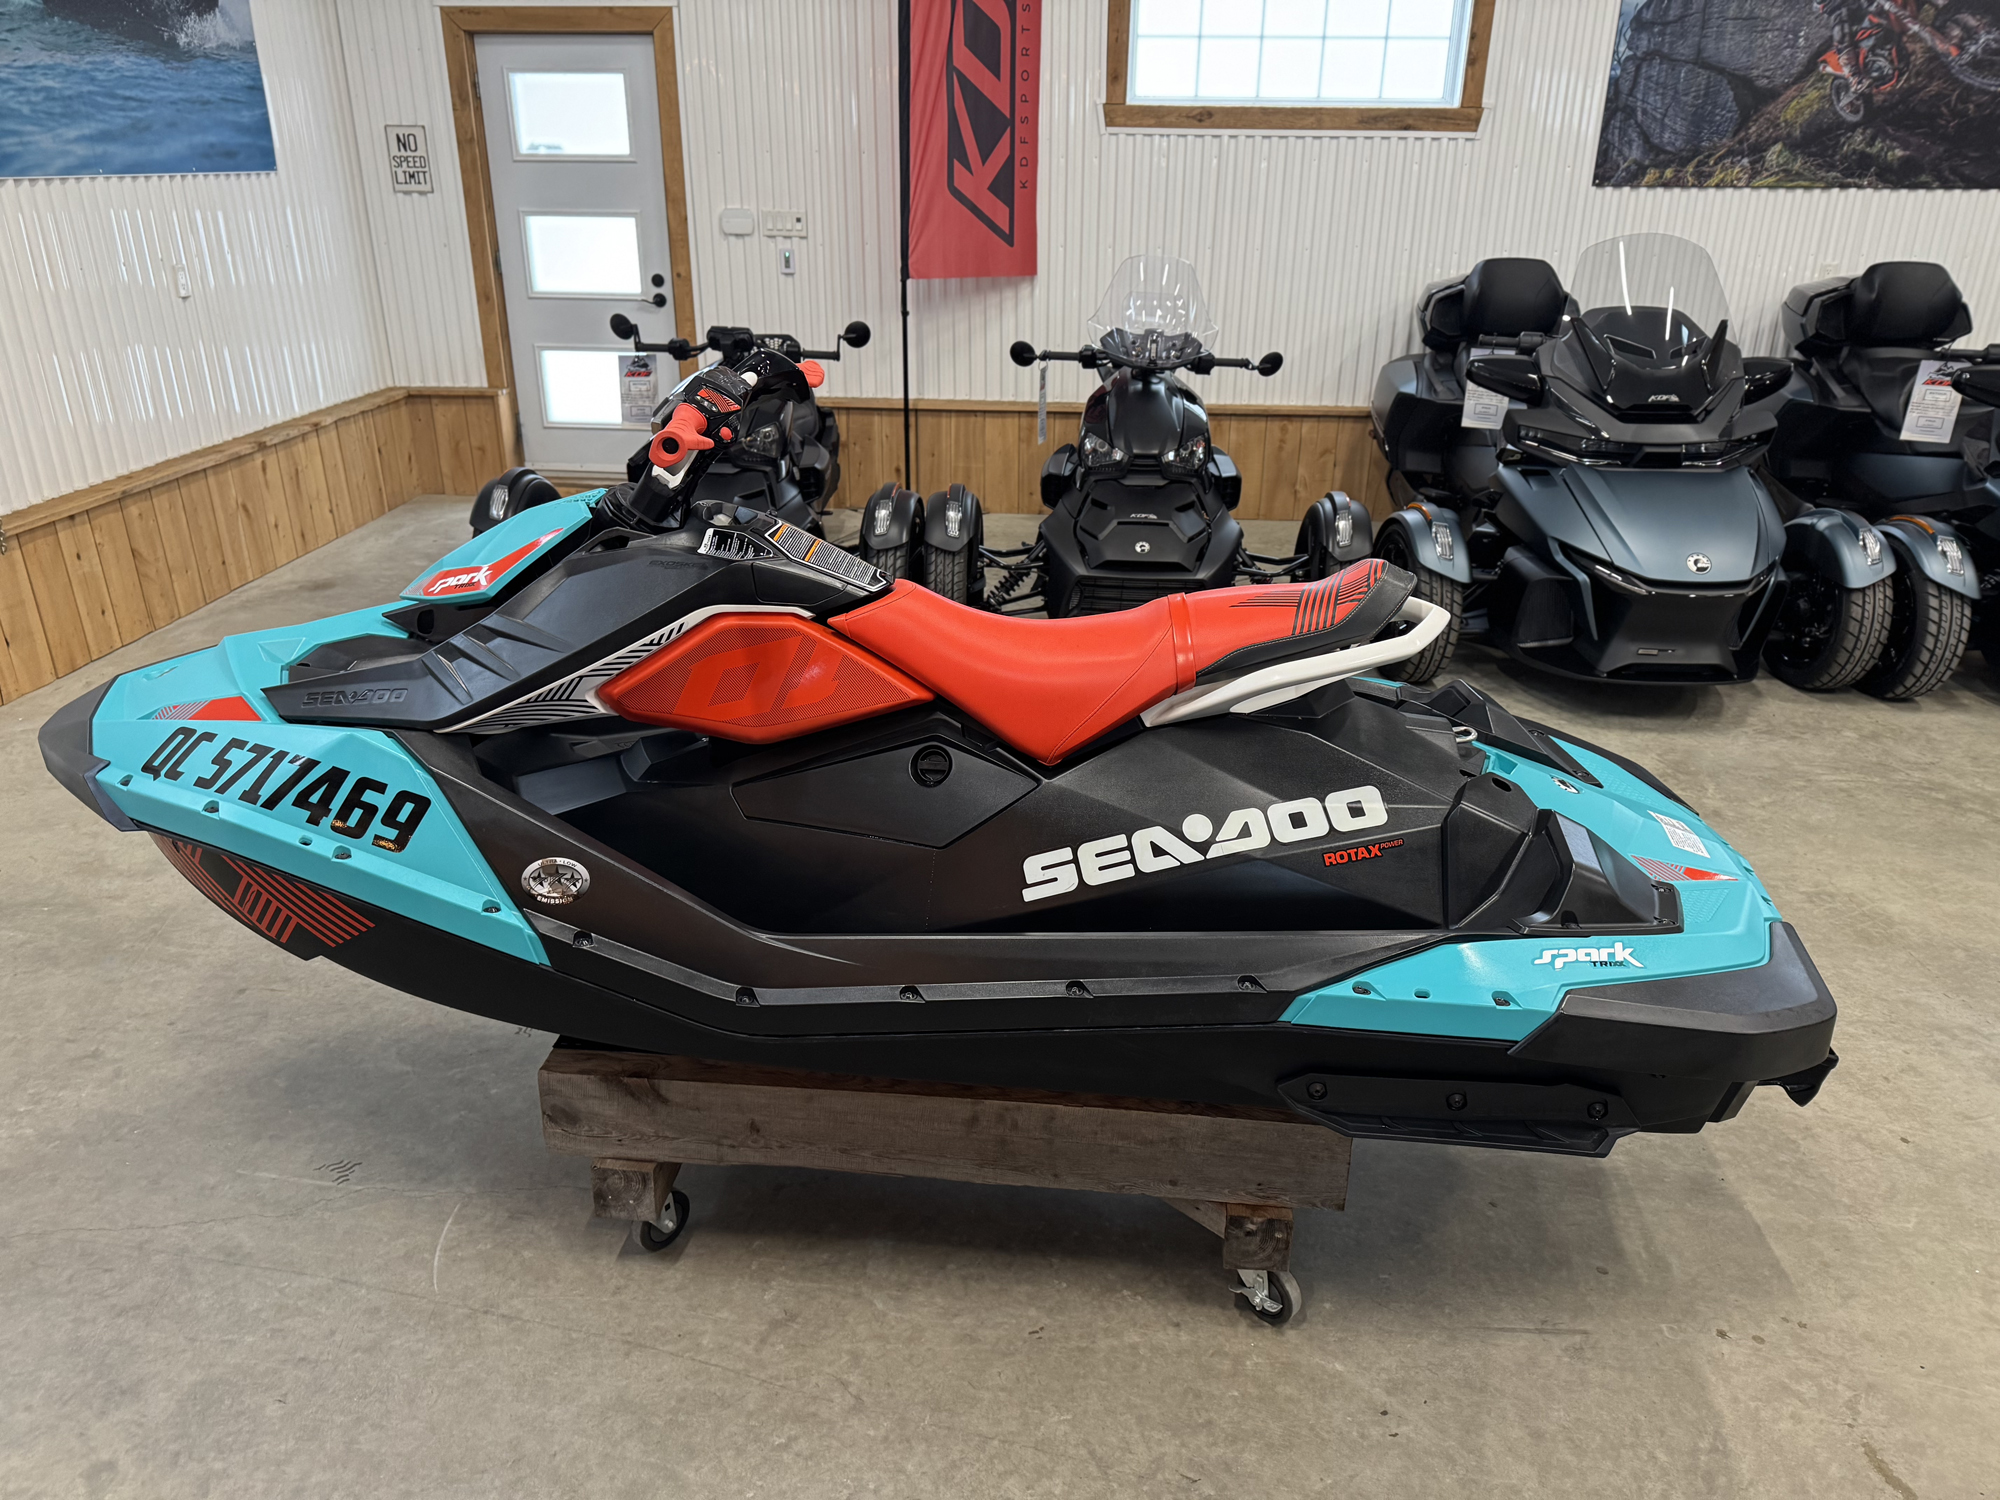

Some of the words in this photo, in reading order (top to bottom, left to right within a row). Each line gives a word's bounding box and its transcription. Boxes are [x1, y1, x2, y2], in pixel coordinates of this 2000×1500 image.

[396, 133, 418, 153] NO
[392, 155, 427, 169] SPEED
[394, 170, 428, 185] LIMIT
[428, 566, 493, 594] spark
[141, 726, 218, 781] QC
[193, 737, 432, 853] 5717469
[1323, 844, 1382, 867] ROTAX
[1380, 839, 1404, 849] POWER
[1534, 942, 1644, 969] spark
